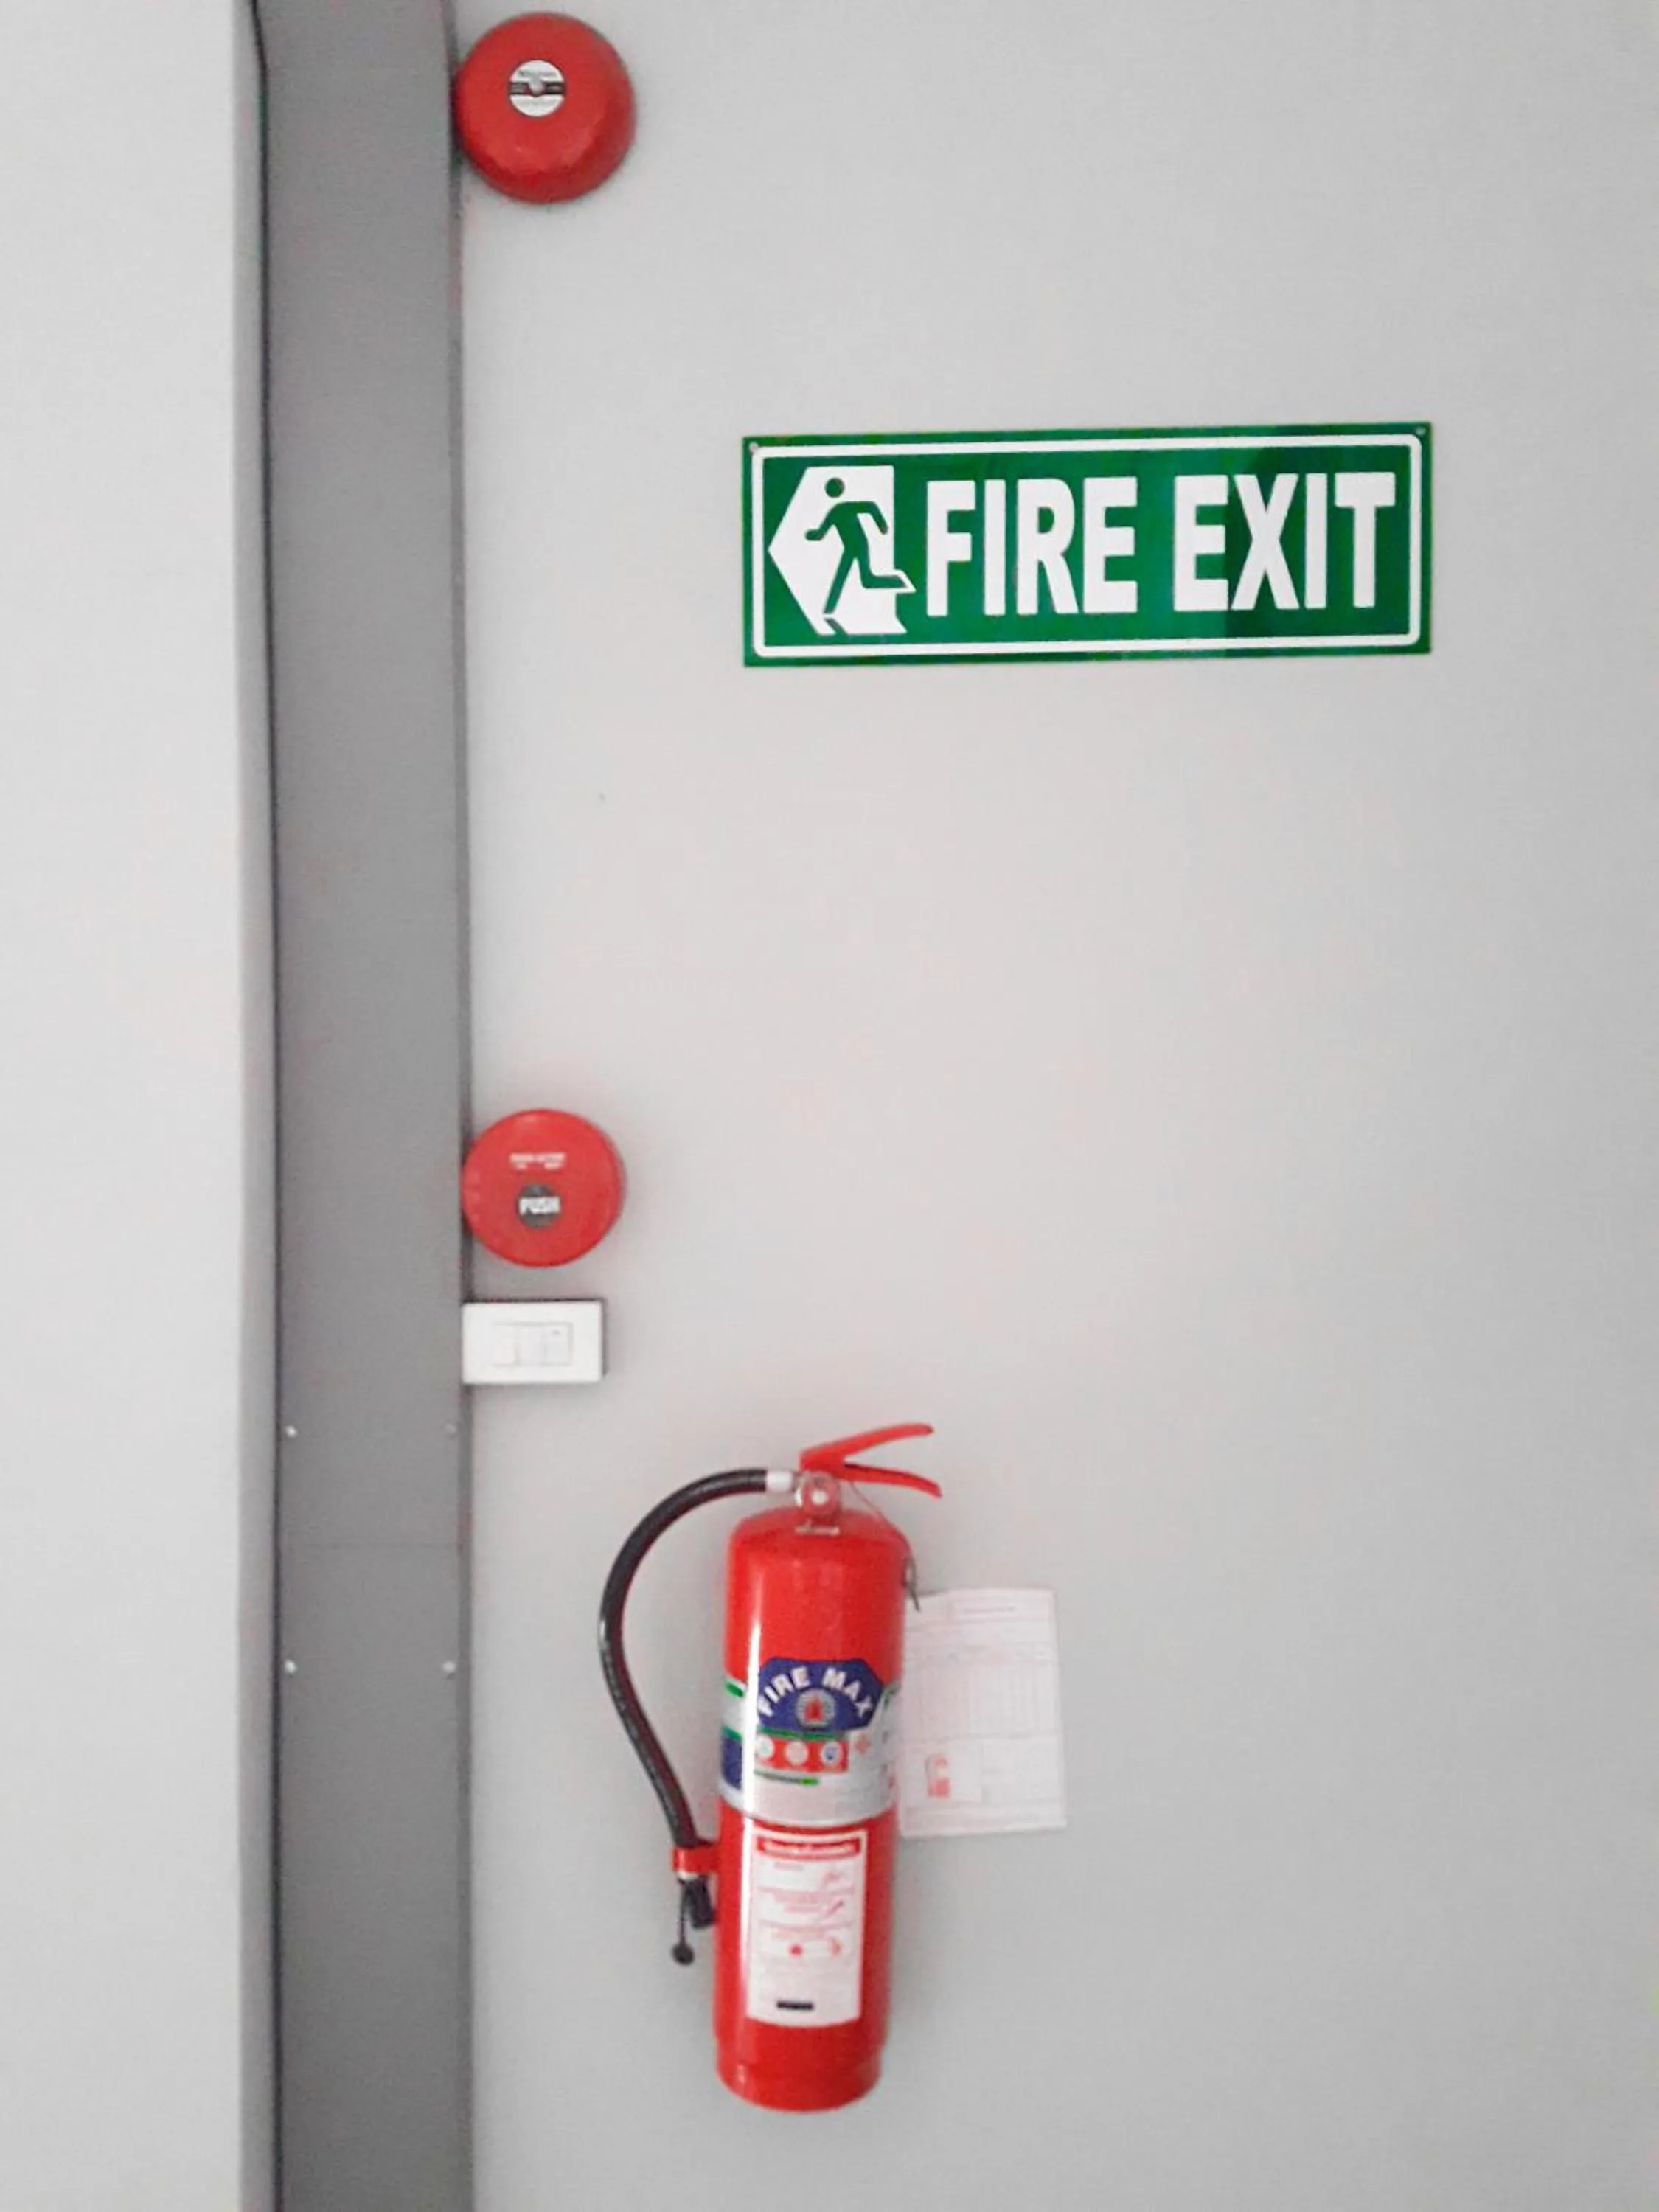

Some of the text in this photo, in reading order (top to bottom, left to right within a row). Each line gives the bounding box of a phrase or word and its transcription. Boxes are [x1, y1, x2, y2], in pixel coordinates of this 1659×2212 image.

[926, 471, 1396, 617] FIRE EXIT
[758, 1666, 873, 1718] FIRE MAX
